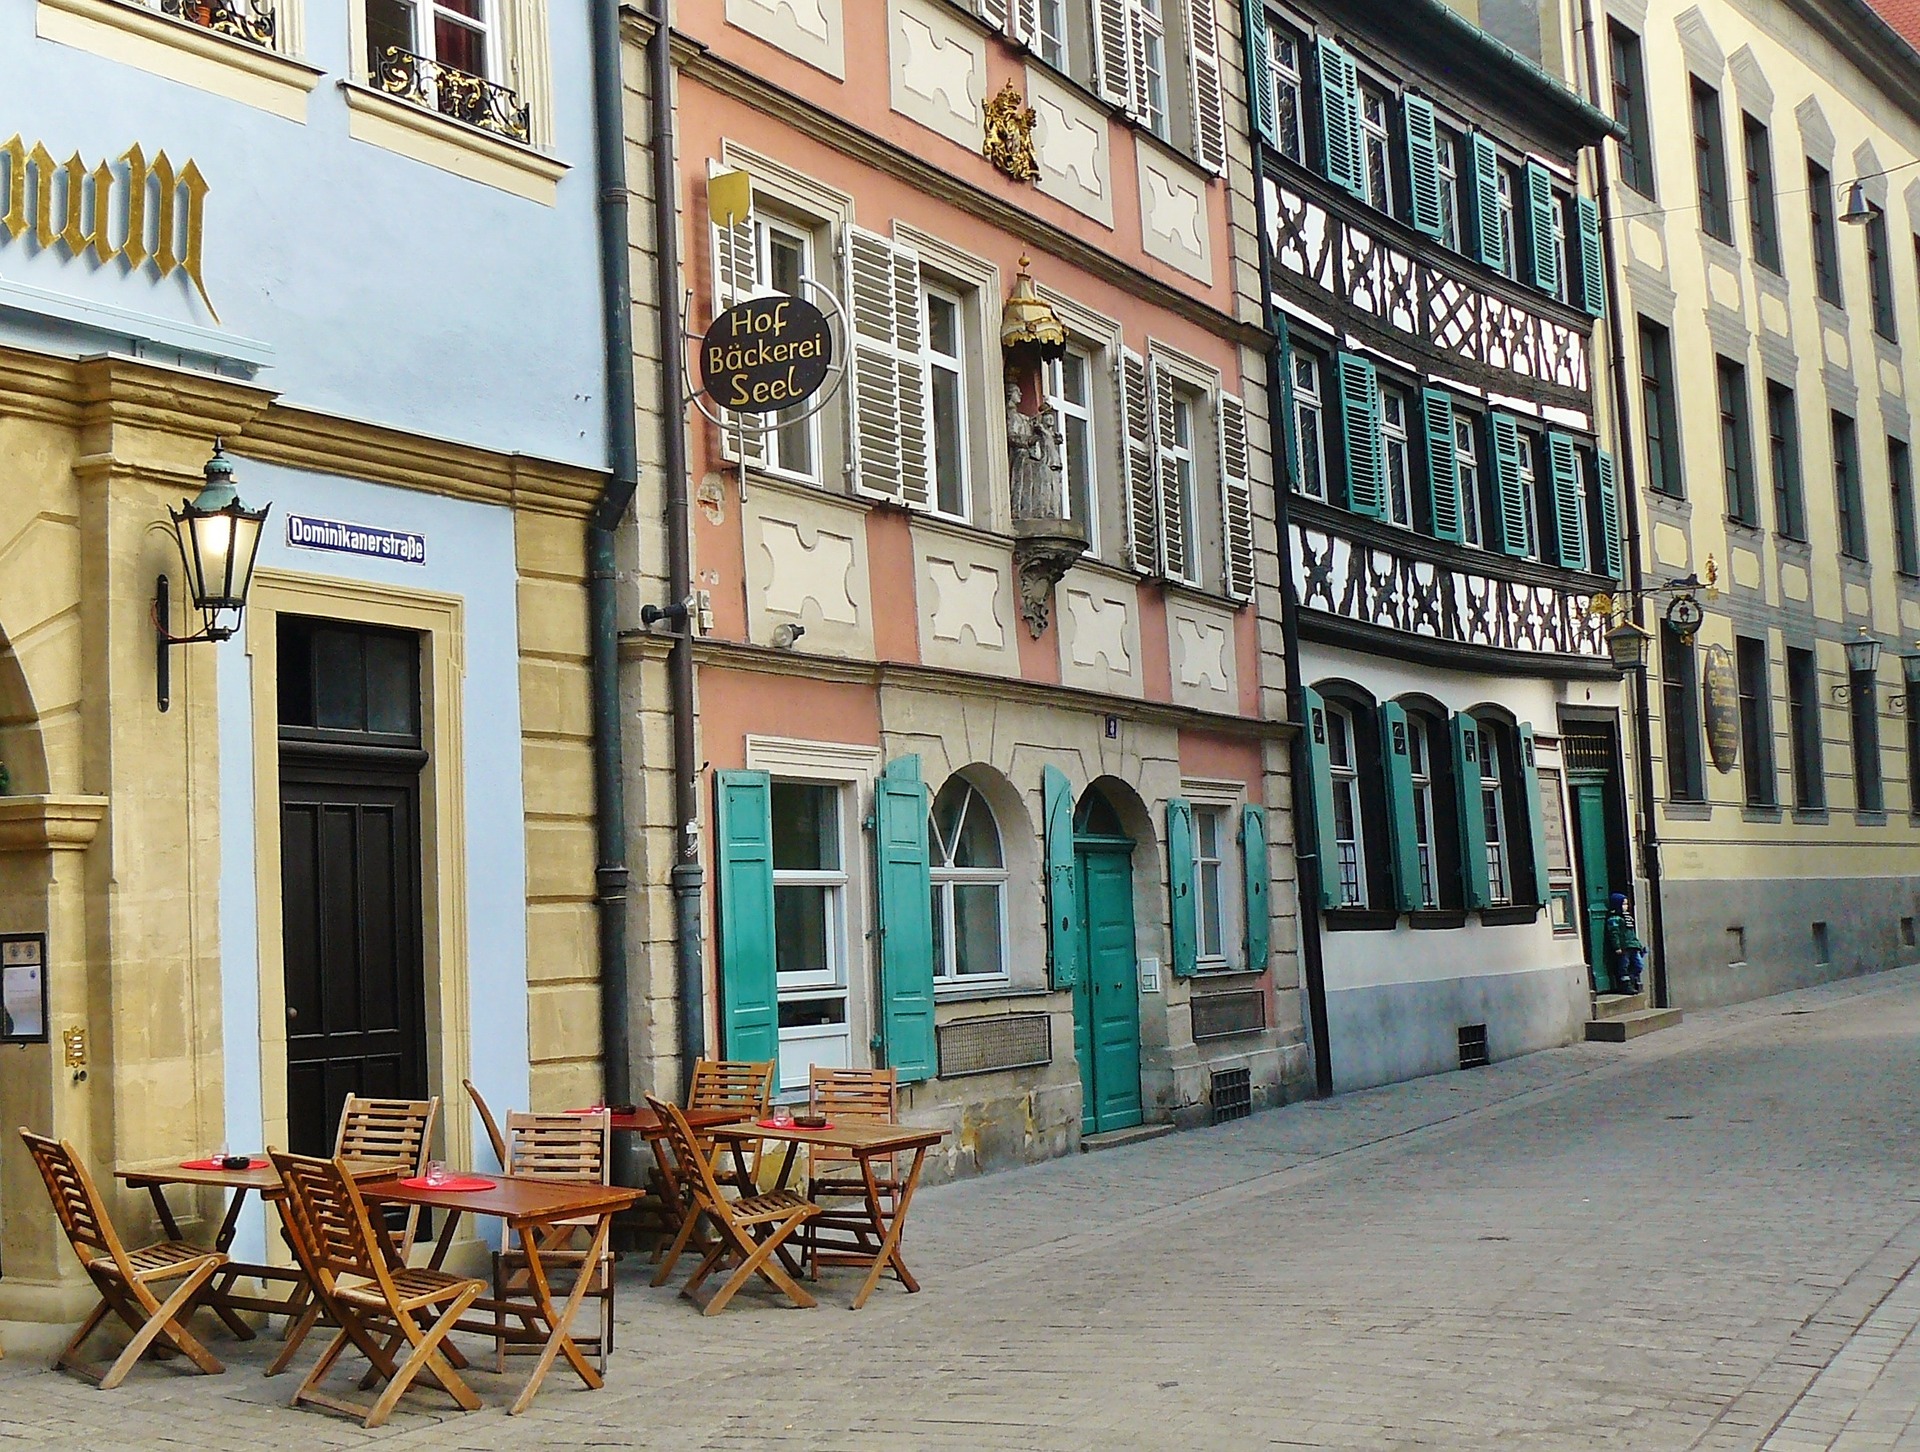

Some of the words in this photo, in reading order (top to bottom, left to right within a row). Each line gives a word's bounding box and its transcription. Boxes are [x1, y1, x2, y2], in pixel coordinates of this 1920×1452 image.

[731, 301, 790, 337] Hof
[709, 333, 821, 374] Bäckerei
[730, 365, 803, 405] Seel
[291, 517, 423, 560] Dominikanerstraße
